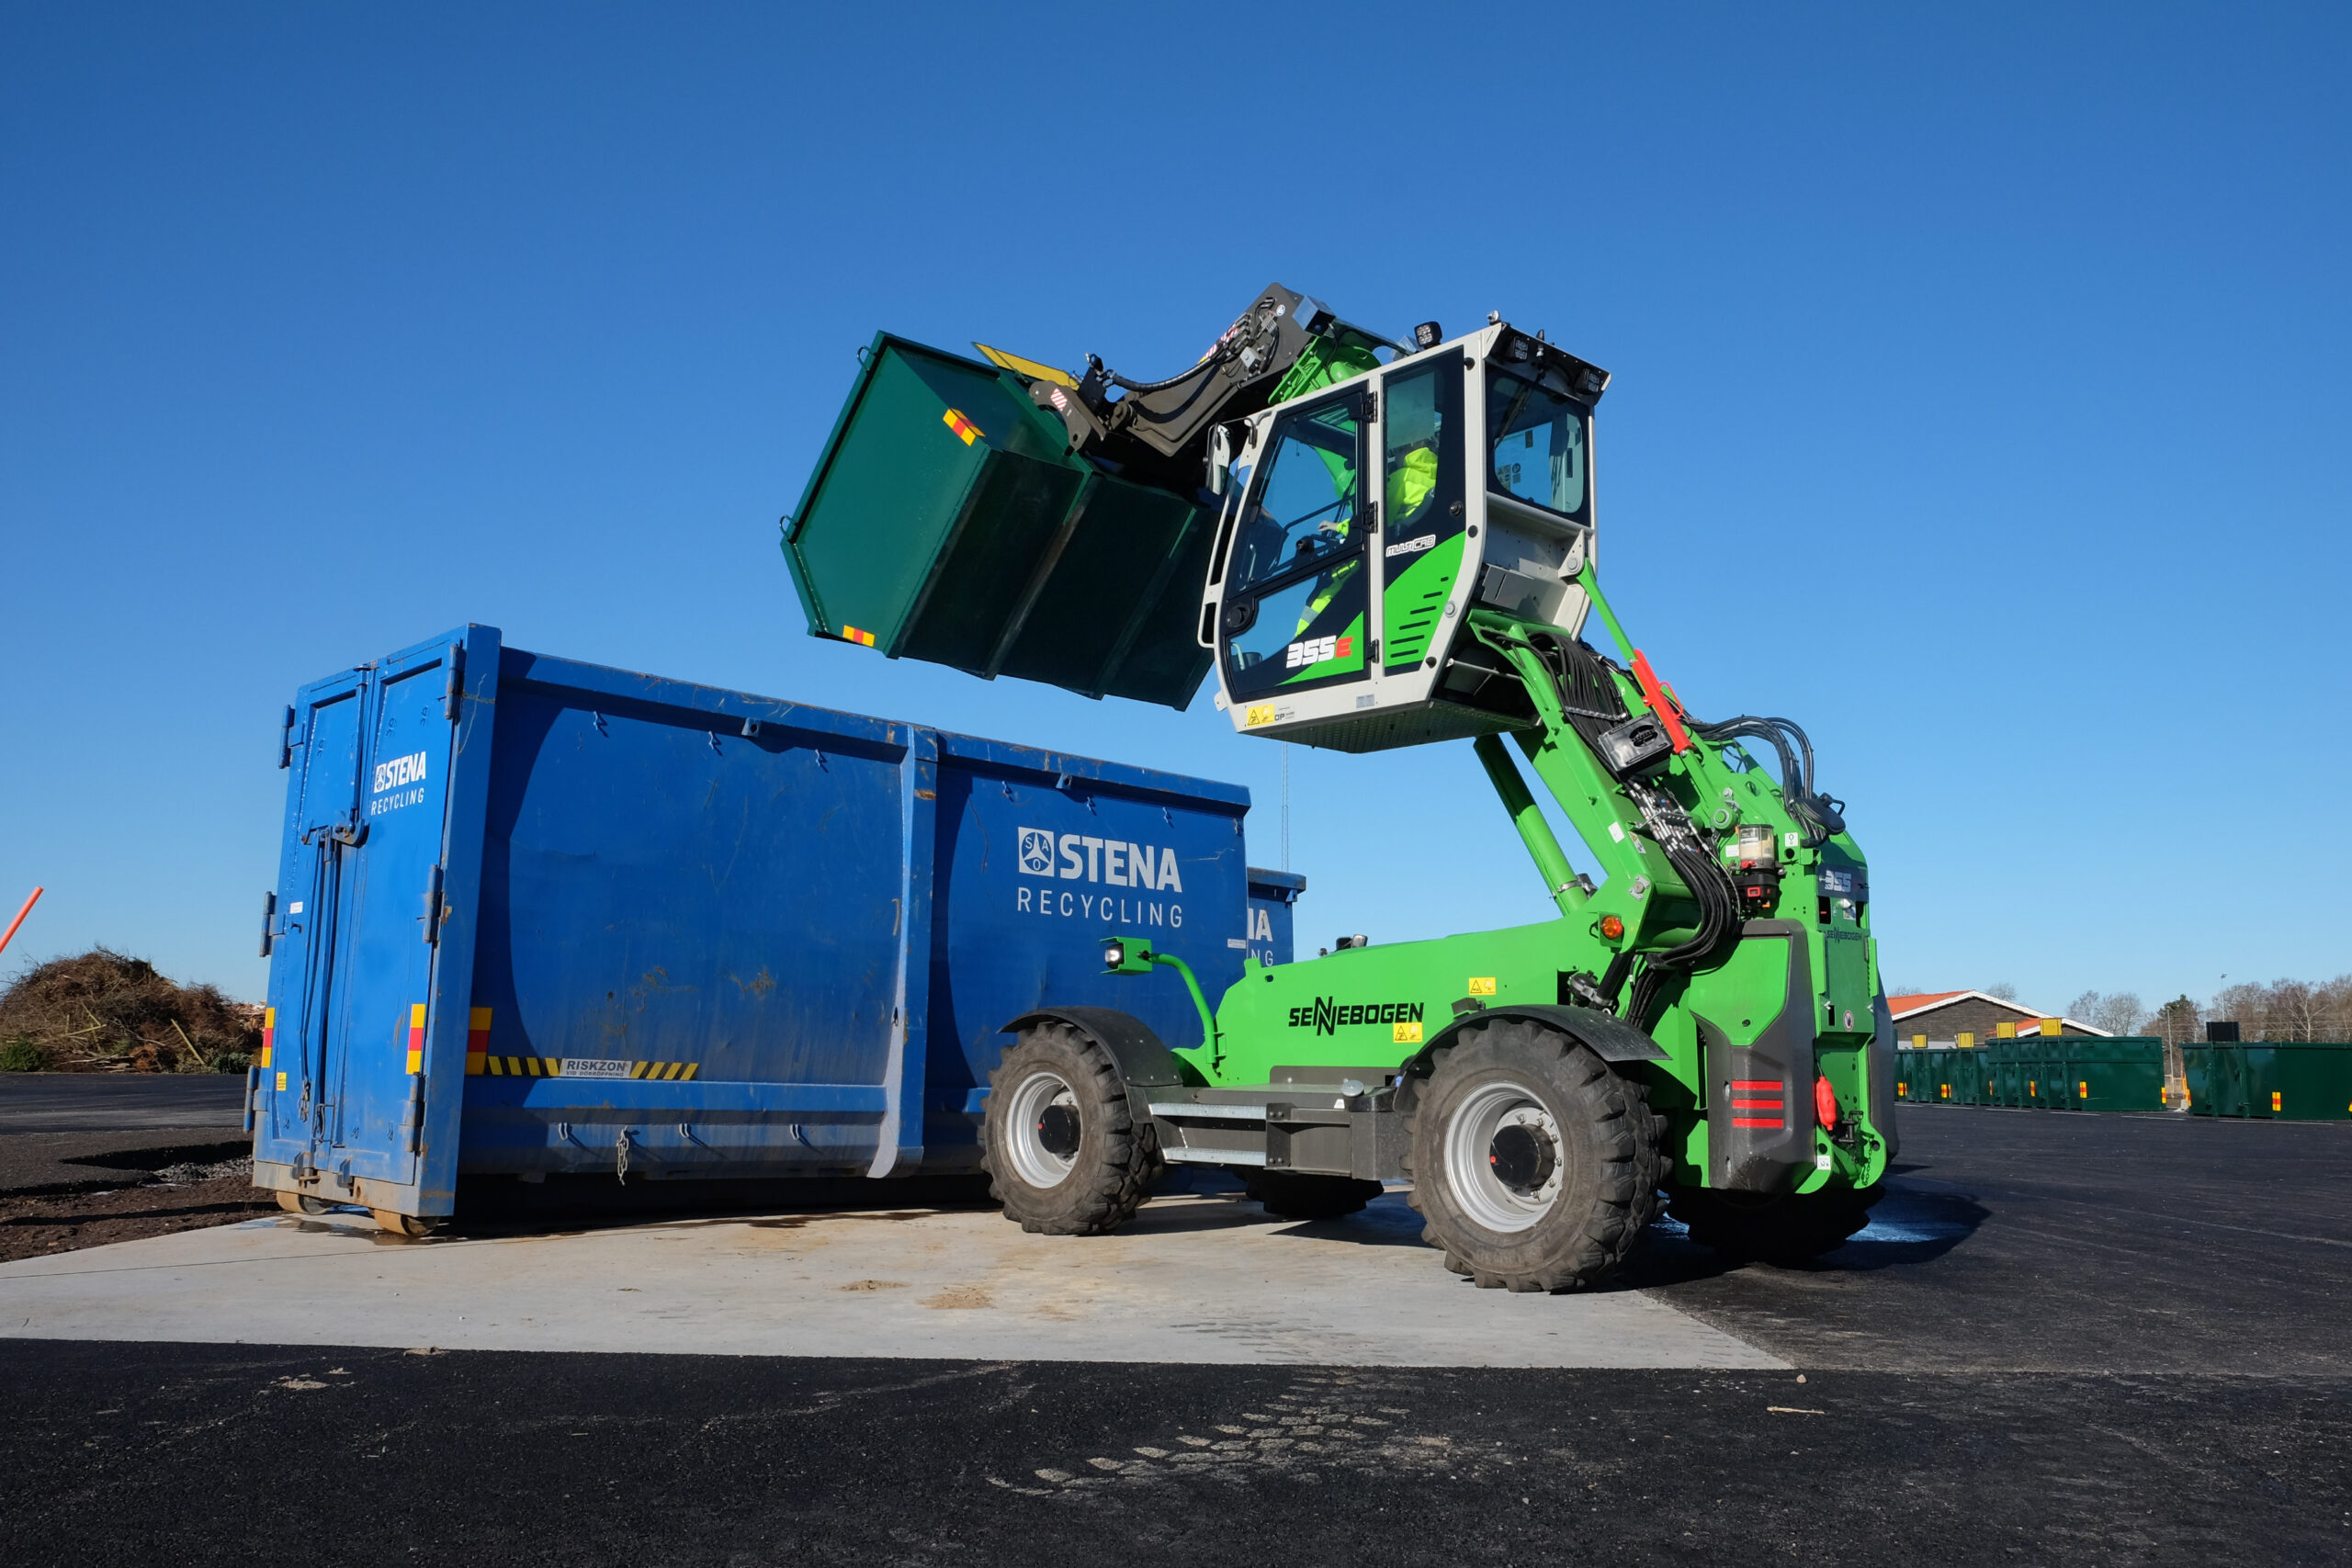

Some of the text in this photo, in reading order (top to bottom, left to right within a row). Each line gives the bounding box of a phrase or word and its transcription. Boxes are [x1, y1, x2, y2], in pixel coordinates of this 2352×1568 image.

[1286, 635, 1353, 669] 355E
[385, 750, 426, 790] STENA
[370, 787, 424, 816] RECYCLING
[1058, 834, 1182, 893] STENA
[1017, 887, 1182, 928] RECYCLING
[1288, 996, 1424, 1036] SENNEBOGEN
[567, 1060, 626, 1072] RISKZON
